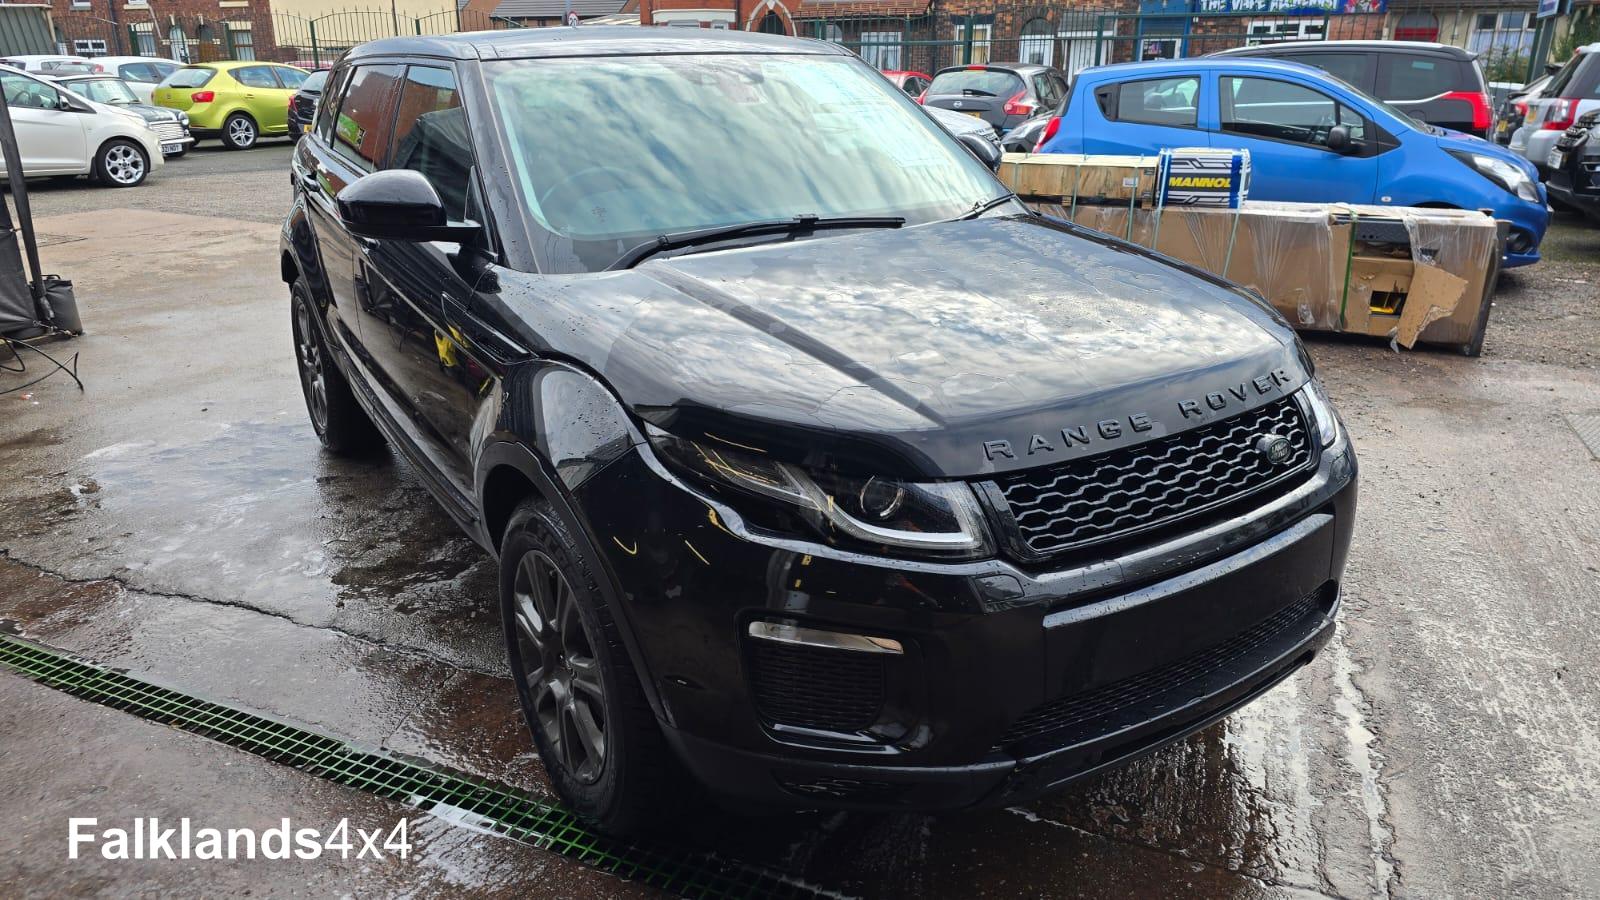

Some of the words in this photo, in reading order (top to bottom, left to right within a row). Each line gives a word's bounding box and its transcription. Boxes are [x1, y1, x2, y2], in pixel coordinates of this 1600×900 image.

[1169, 177, 1231, 188] MANNOL
[982, 411, 1153, 461] RANGE
[1177, 367, 1292, 418] ROVER
